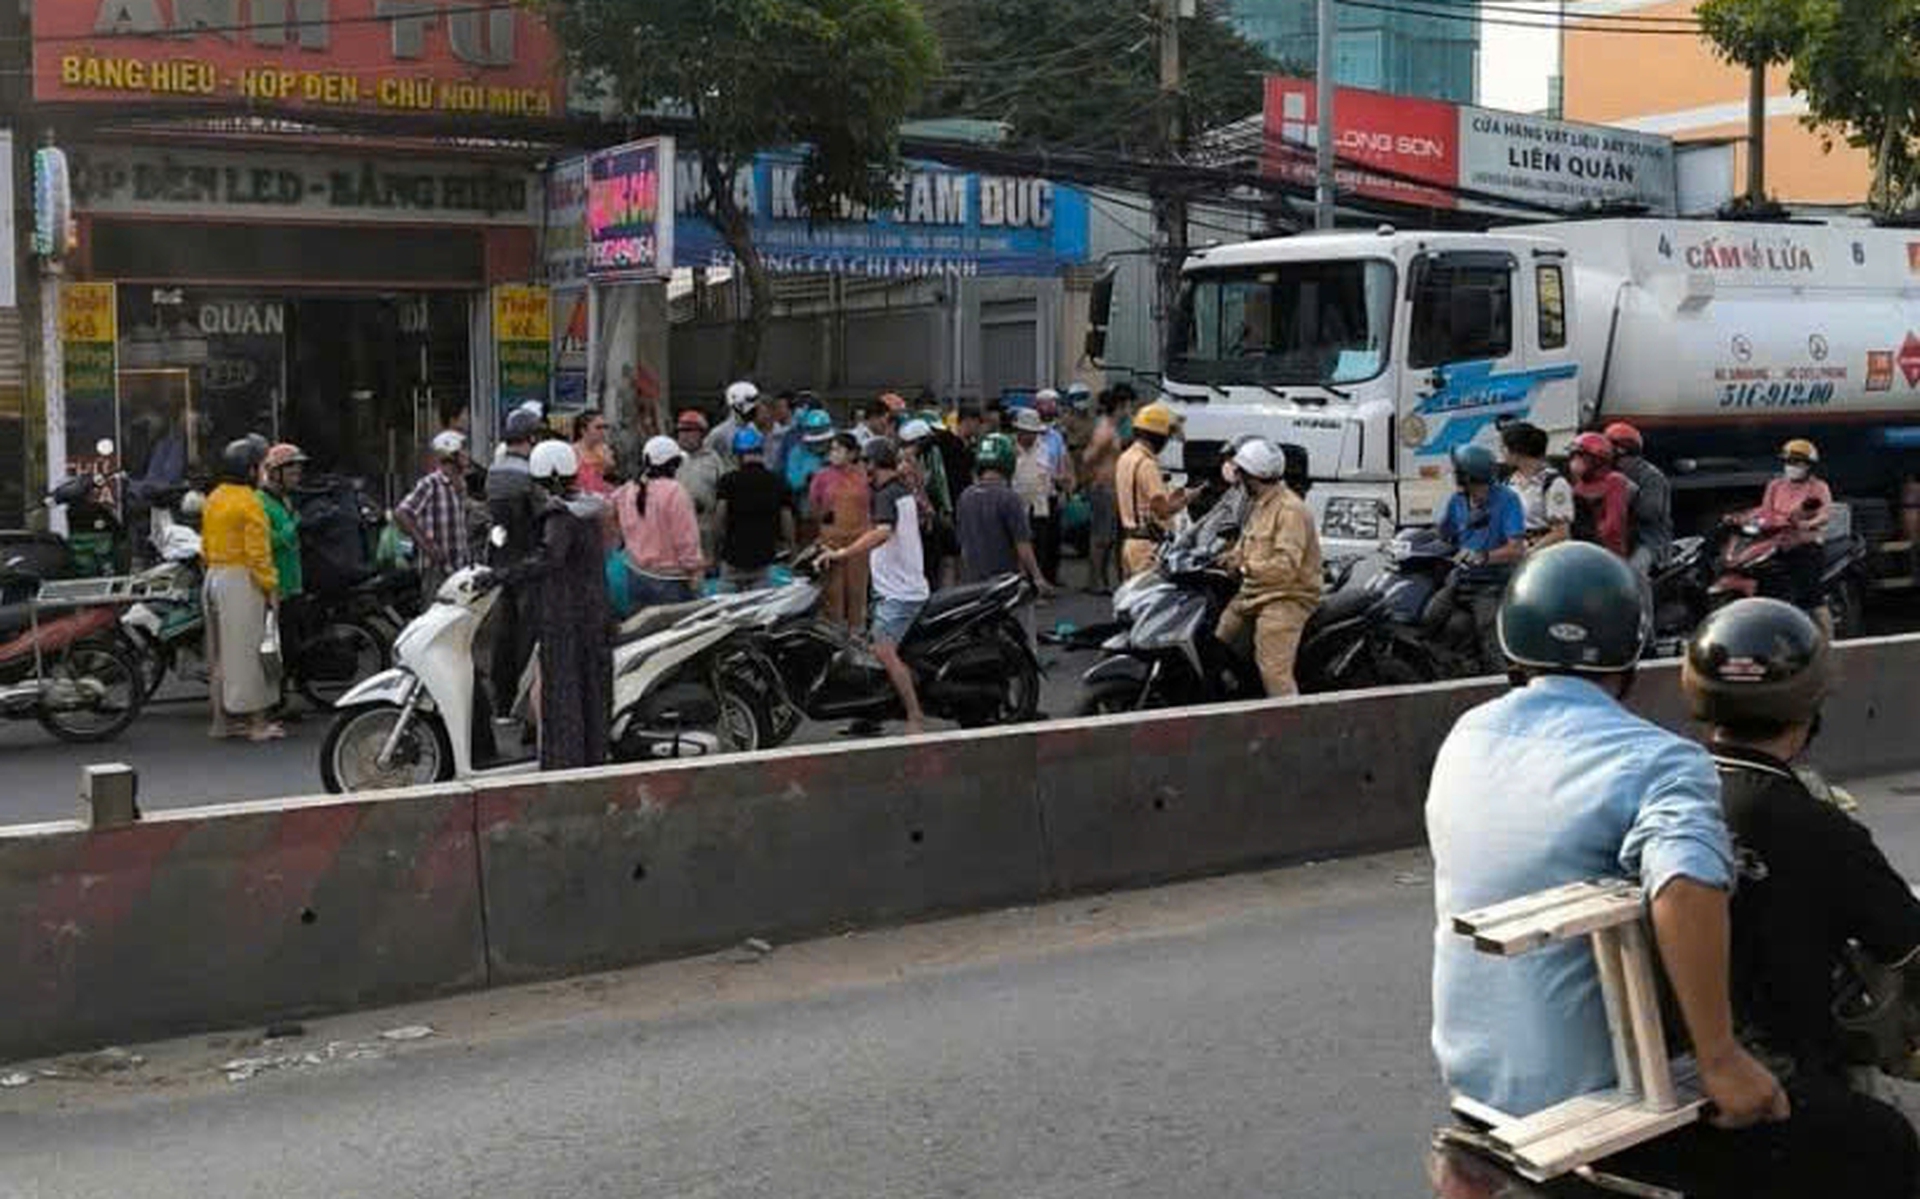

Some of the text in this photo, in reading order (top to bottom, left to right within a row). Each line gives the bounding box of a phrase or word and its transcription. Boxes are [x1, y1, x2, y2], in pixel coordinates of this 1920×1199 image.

[1658, 233, 1866, 271] 4 CẤM LỬA 6
